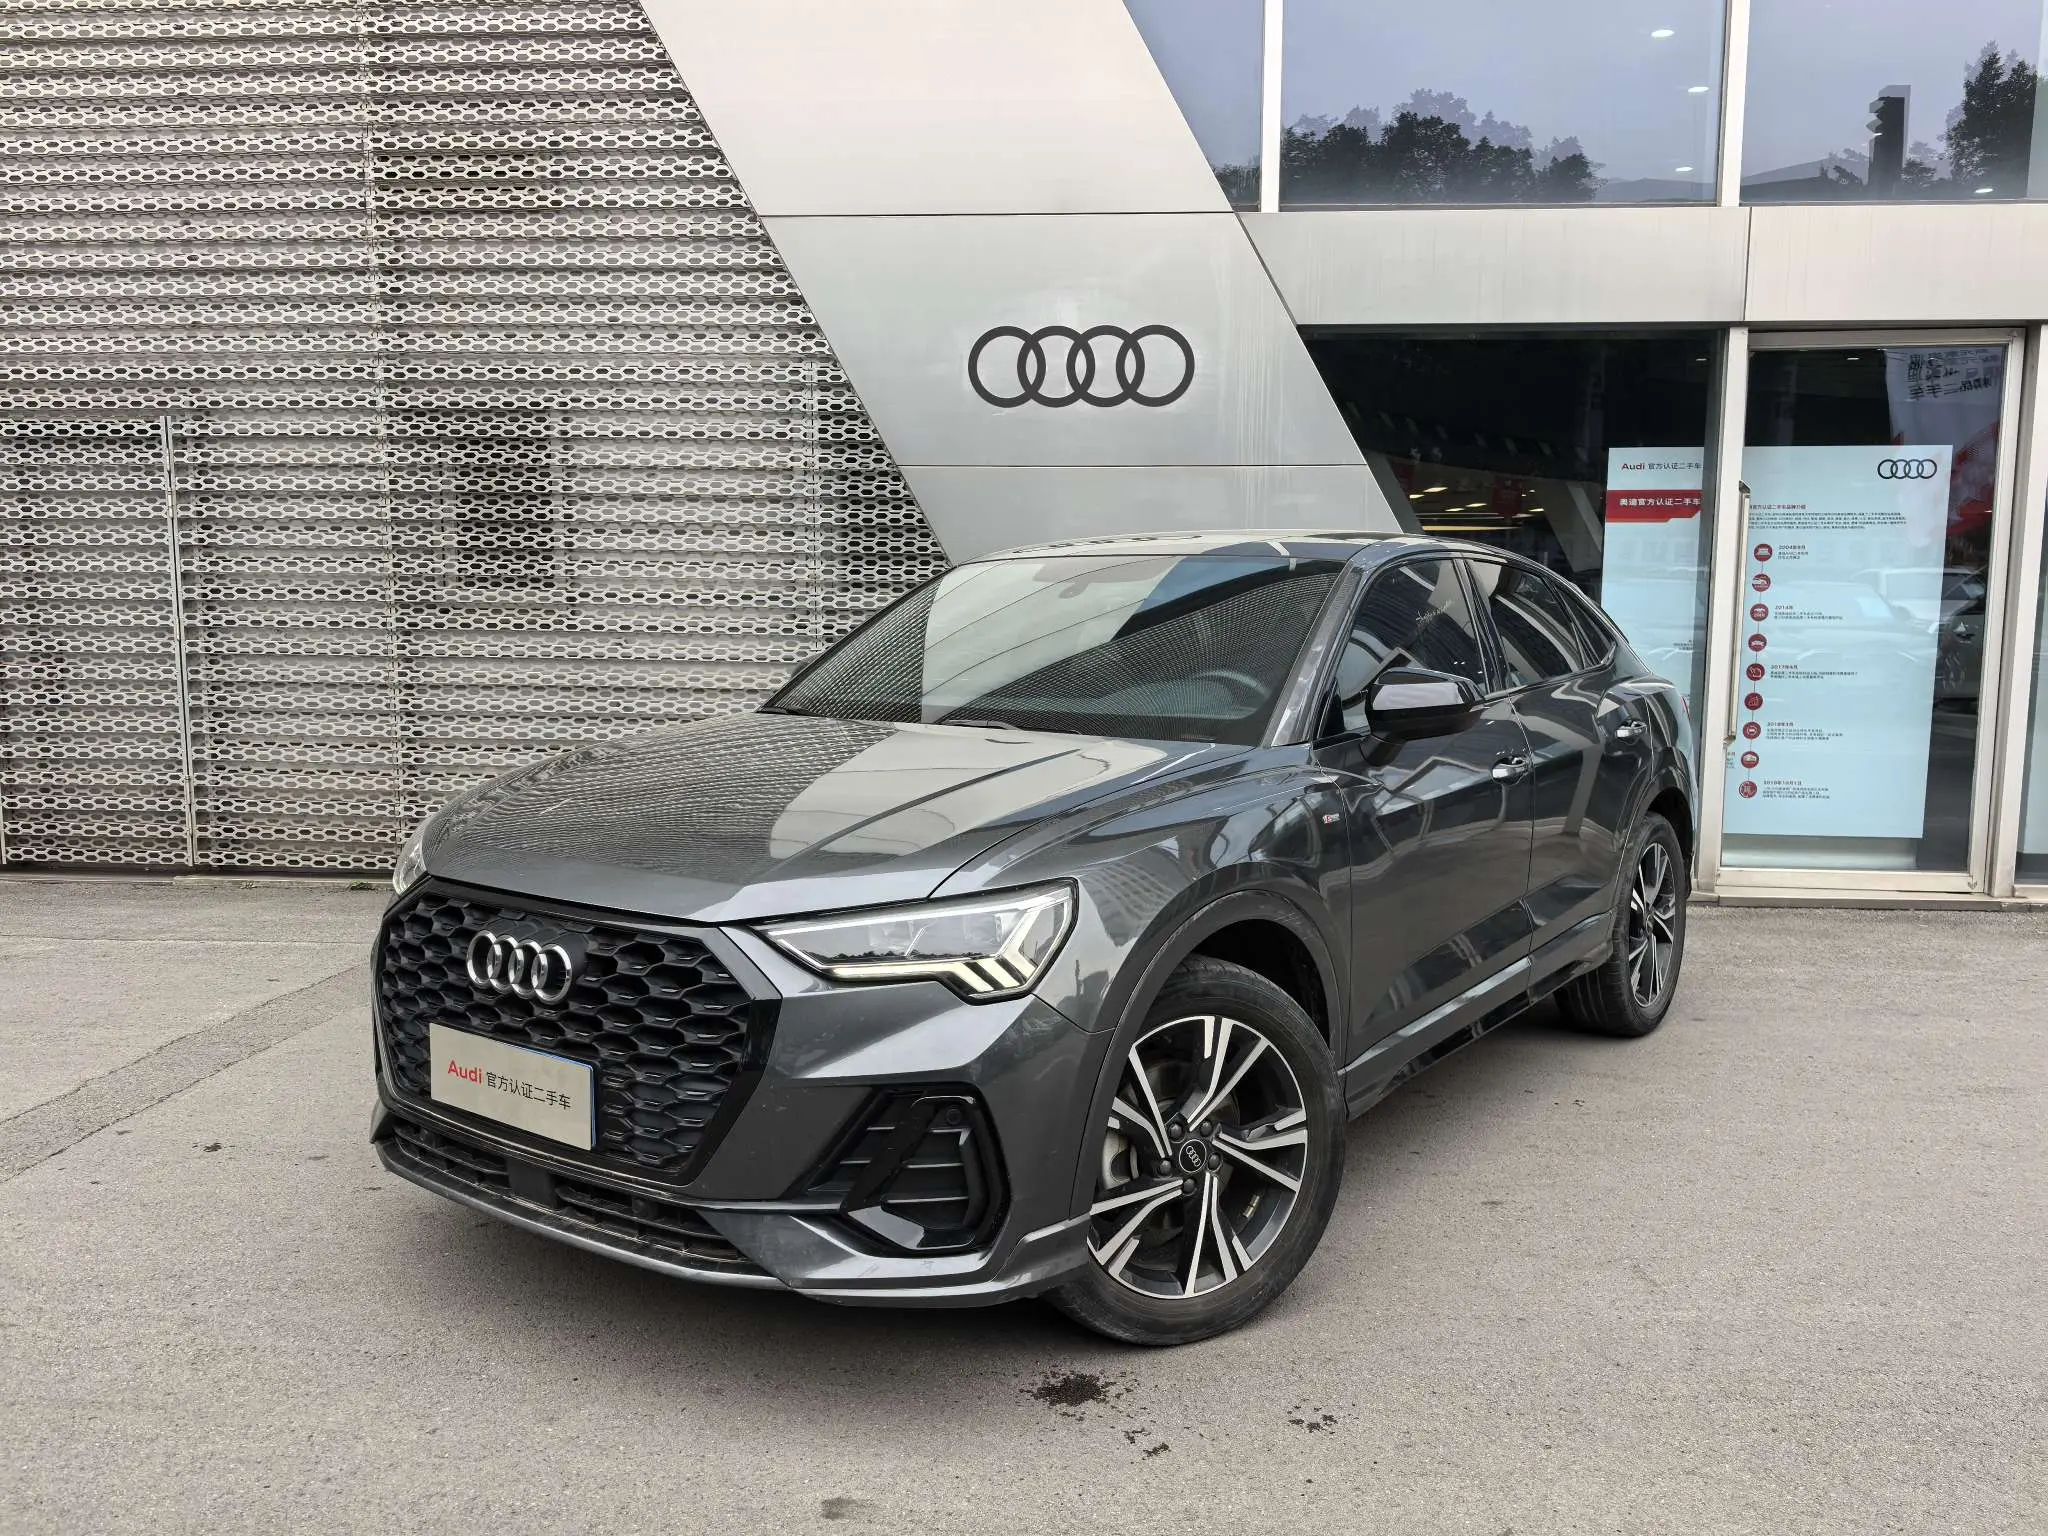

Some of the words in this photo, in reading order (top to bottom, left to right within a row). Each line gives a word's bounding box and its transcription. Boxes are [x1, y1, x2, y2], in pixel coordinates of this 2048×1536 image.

[1621, 462, 1645, 470] Audi
[1648, 462, 1701, 470] 官方认证二手车
[447, 1059, 483, 1085] Audi
[486, 1071, 571, 1110] 官方认证二手车
